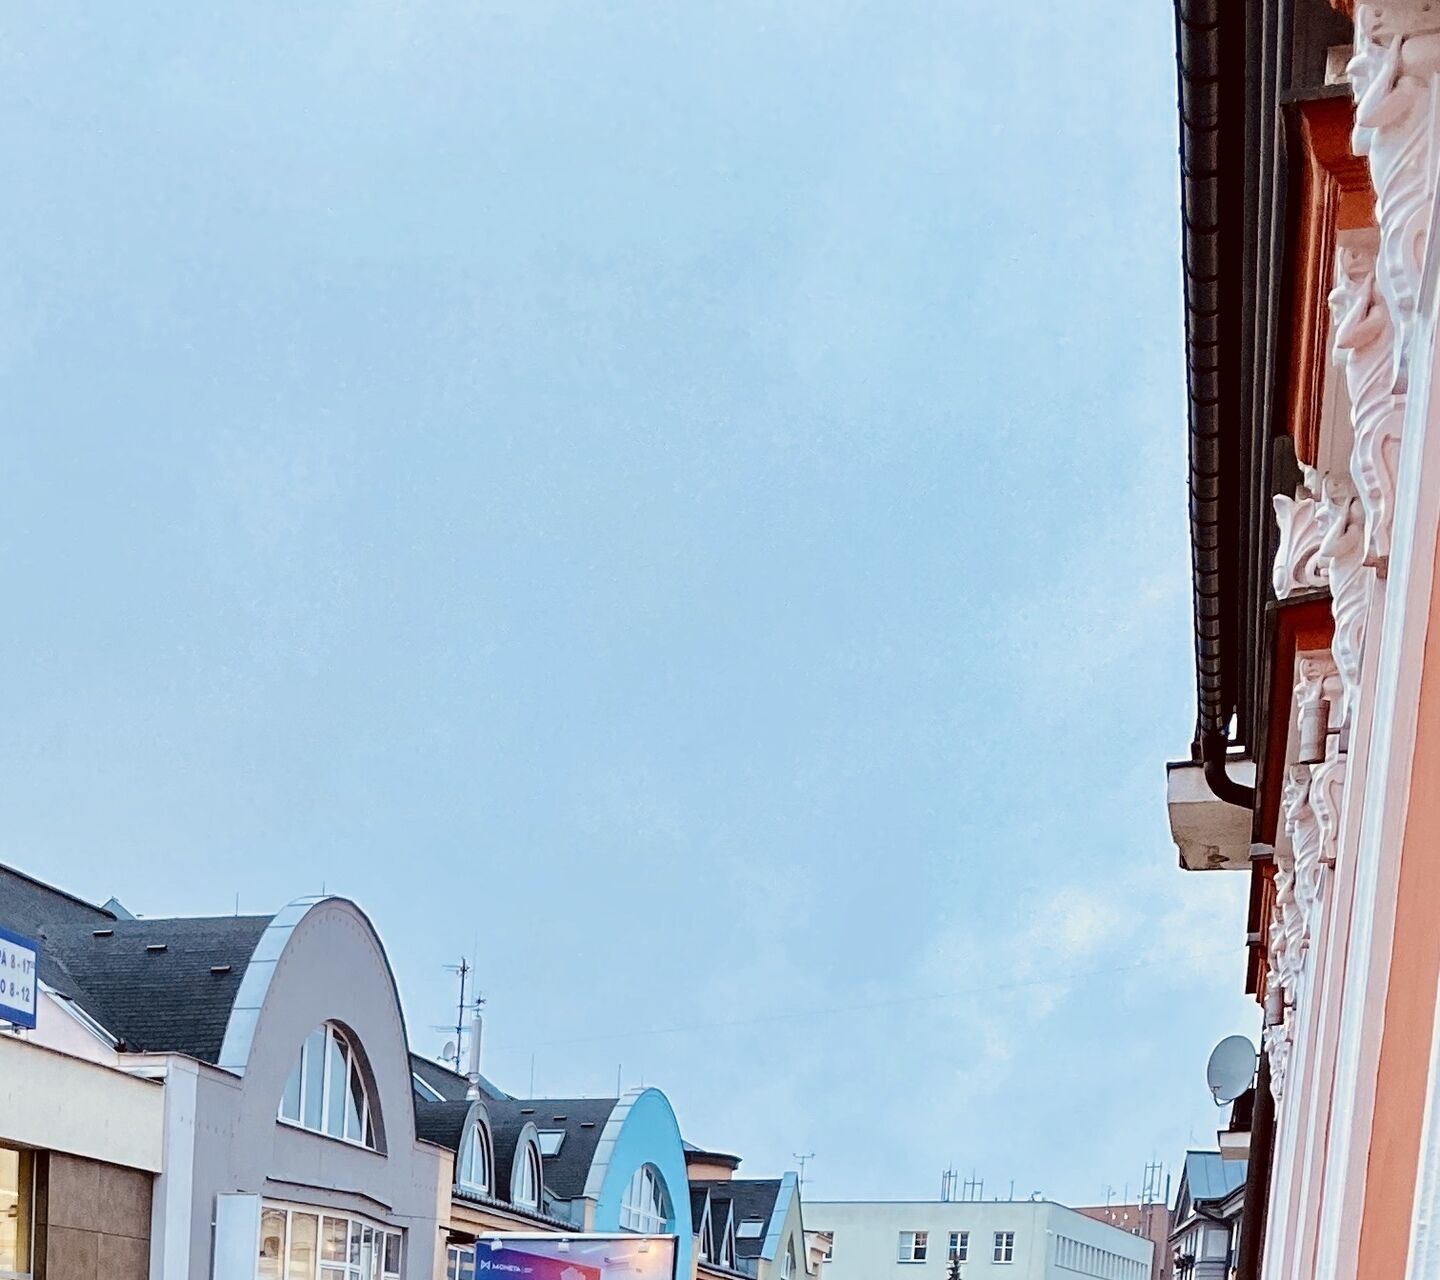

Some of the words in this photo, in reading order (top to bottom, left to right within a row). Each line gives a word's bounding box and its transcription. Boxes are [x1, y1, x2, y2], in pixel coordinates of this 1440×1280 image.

[11, 954, 16, 968] 8
[10, 982, 15, 997] 8
[22, 986, 30, 1002] 12
[492, 1262, 521, 1273] MONETA
